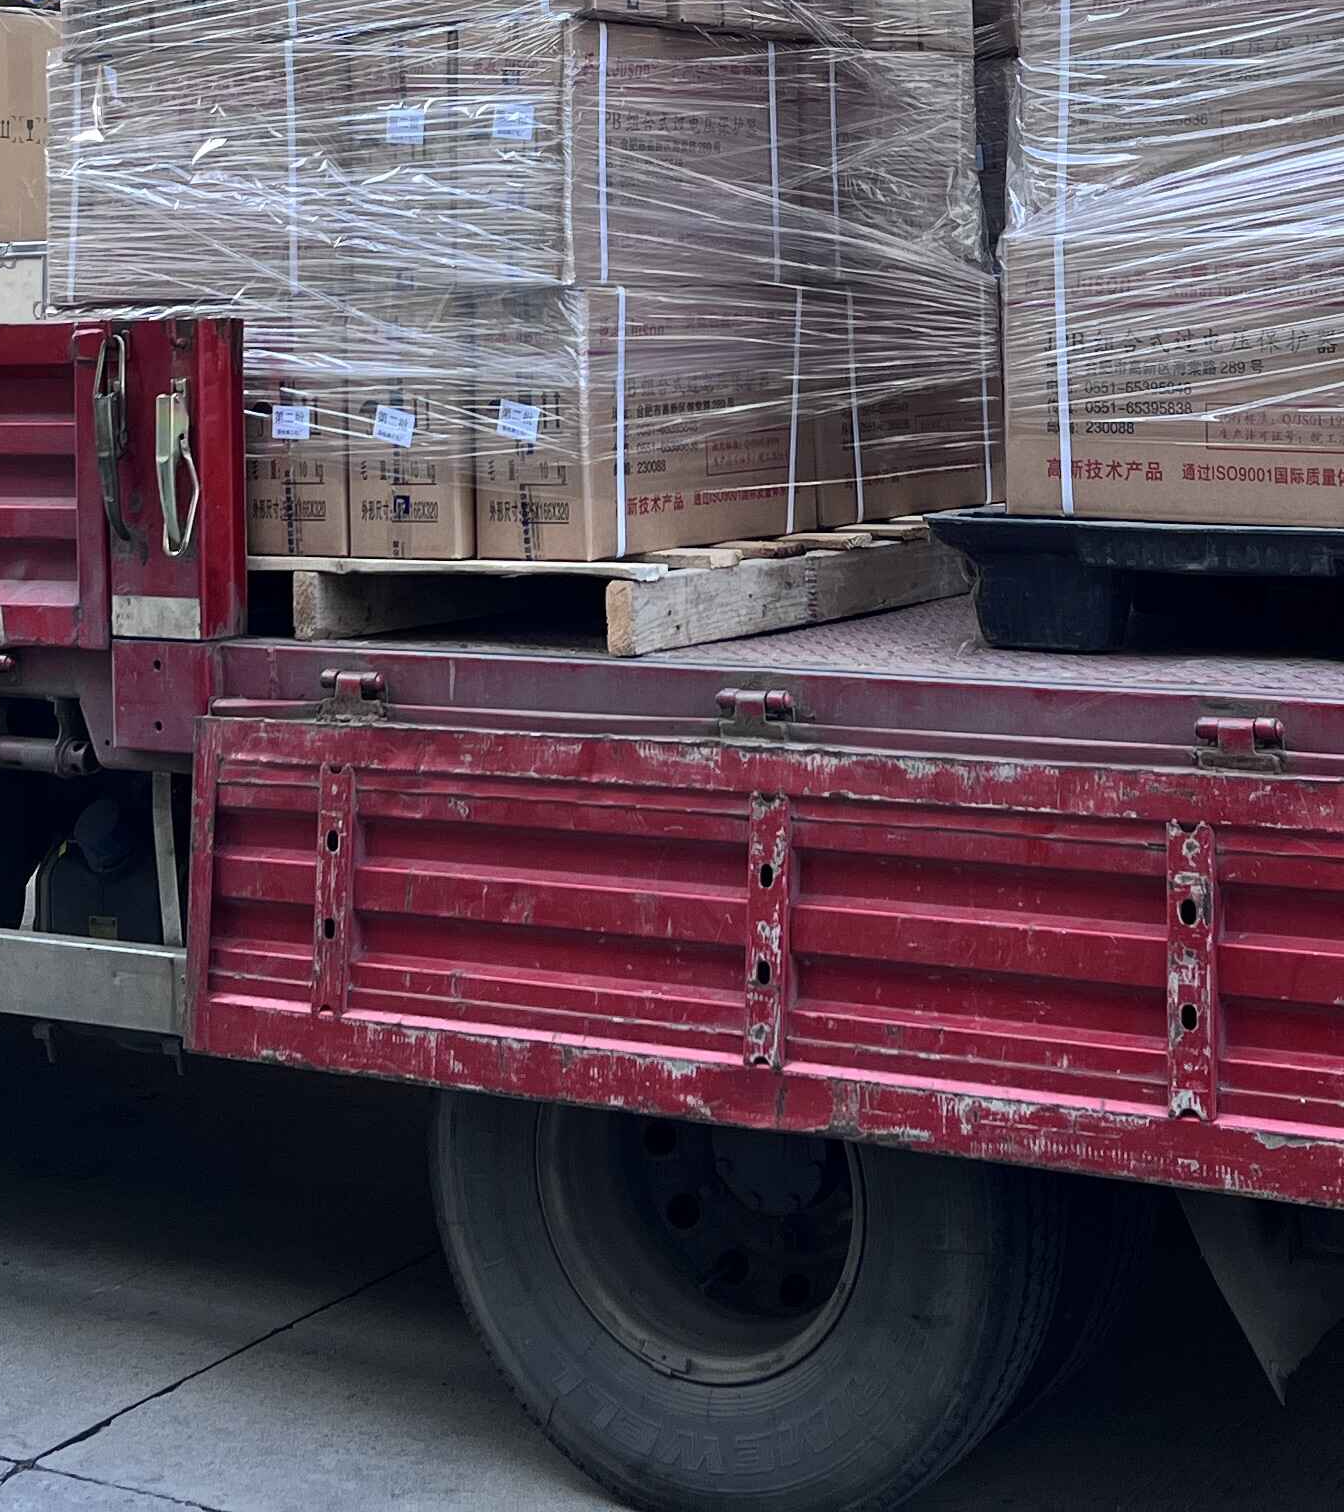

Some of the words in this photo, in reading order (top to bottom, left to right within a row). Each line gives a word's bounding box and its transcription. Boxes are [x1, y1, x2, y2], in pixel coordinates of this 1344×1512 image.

[1085, 421, 1135, 436] 230088
[618, 489, 685, 517] 新技术产品
